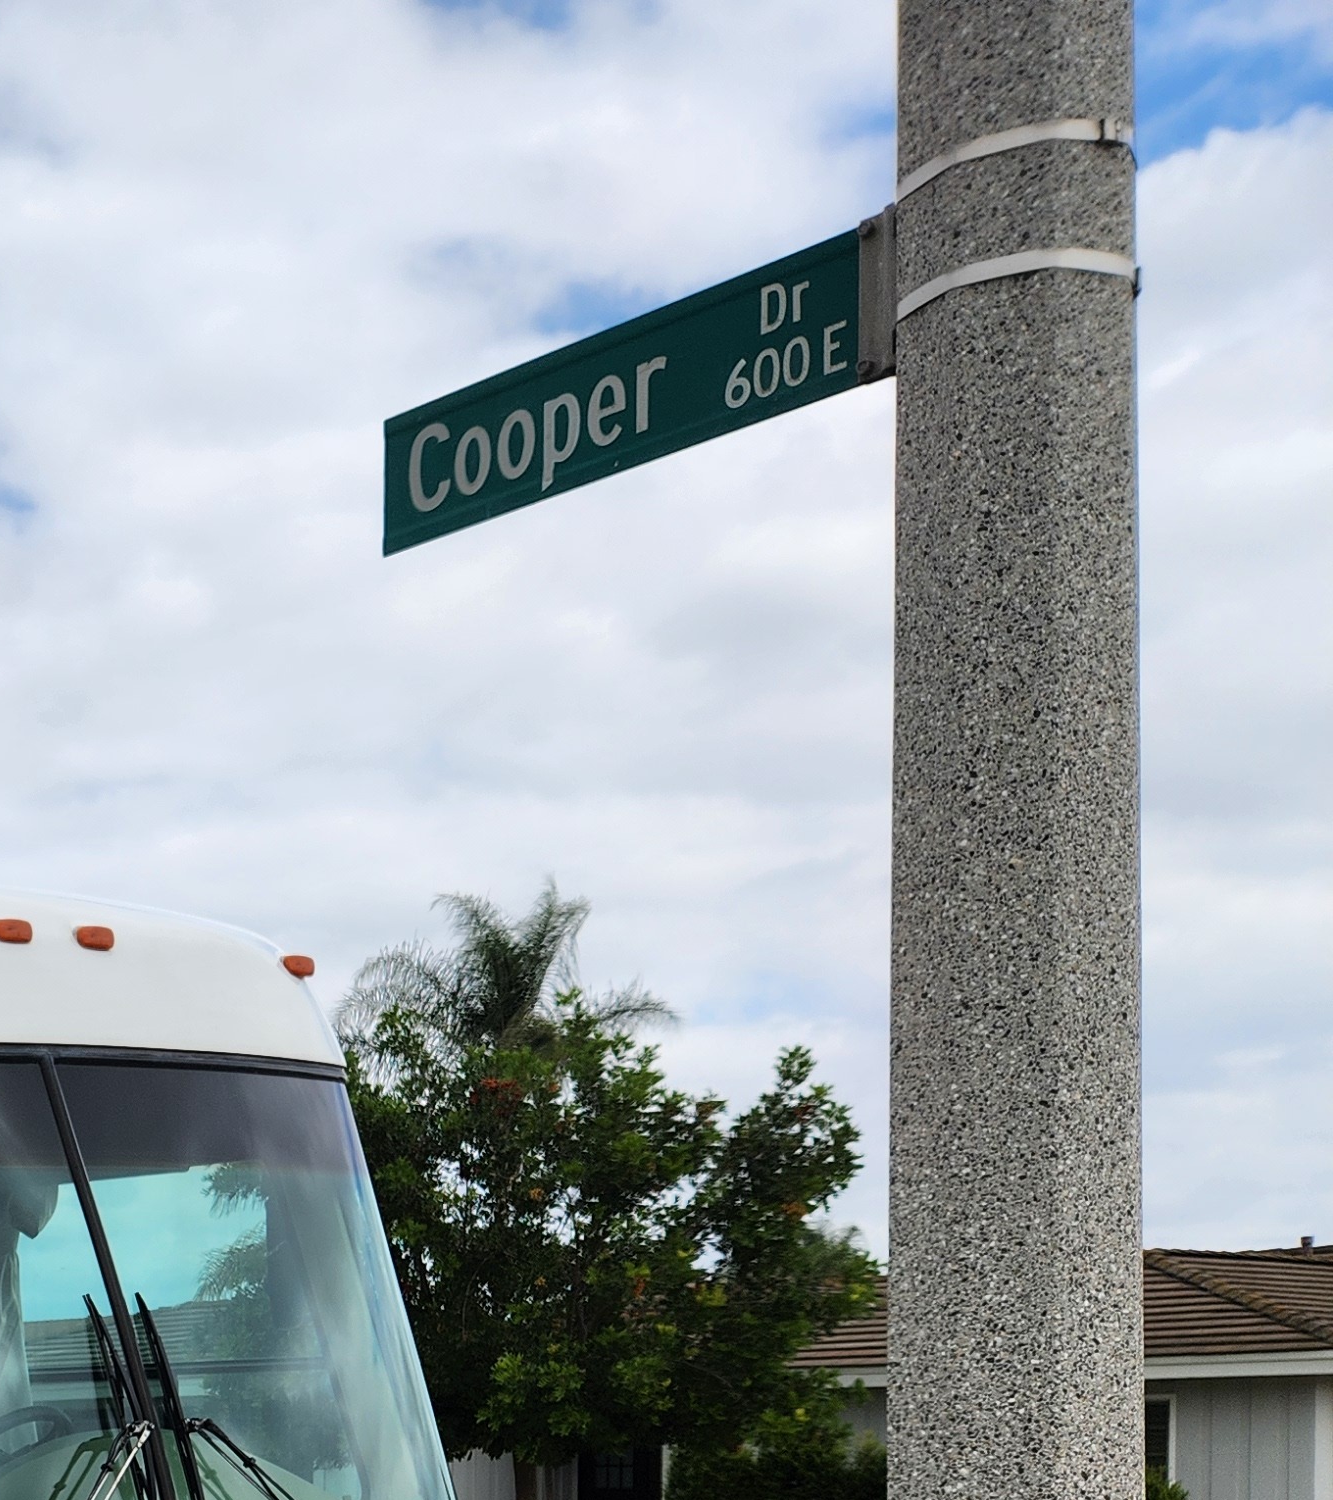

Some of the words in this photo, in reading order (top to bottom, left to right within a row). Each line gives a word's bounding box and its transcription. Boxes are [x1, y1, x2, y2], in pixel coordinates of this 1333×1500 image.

[759, 281, 810, 335] Dr
[724, 336, 811, 409] 600
[823, 320, 848, 376] E
[409, 355, 667, 513] Cooper
